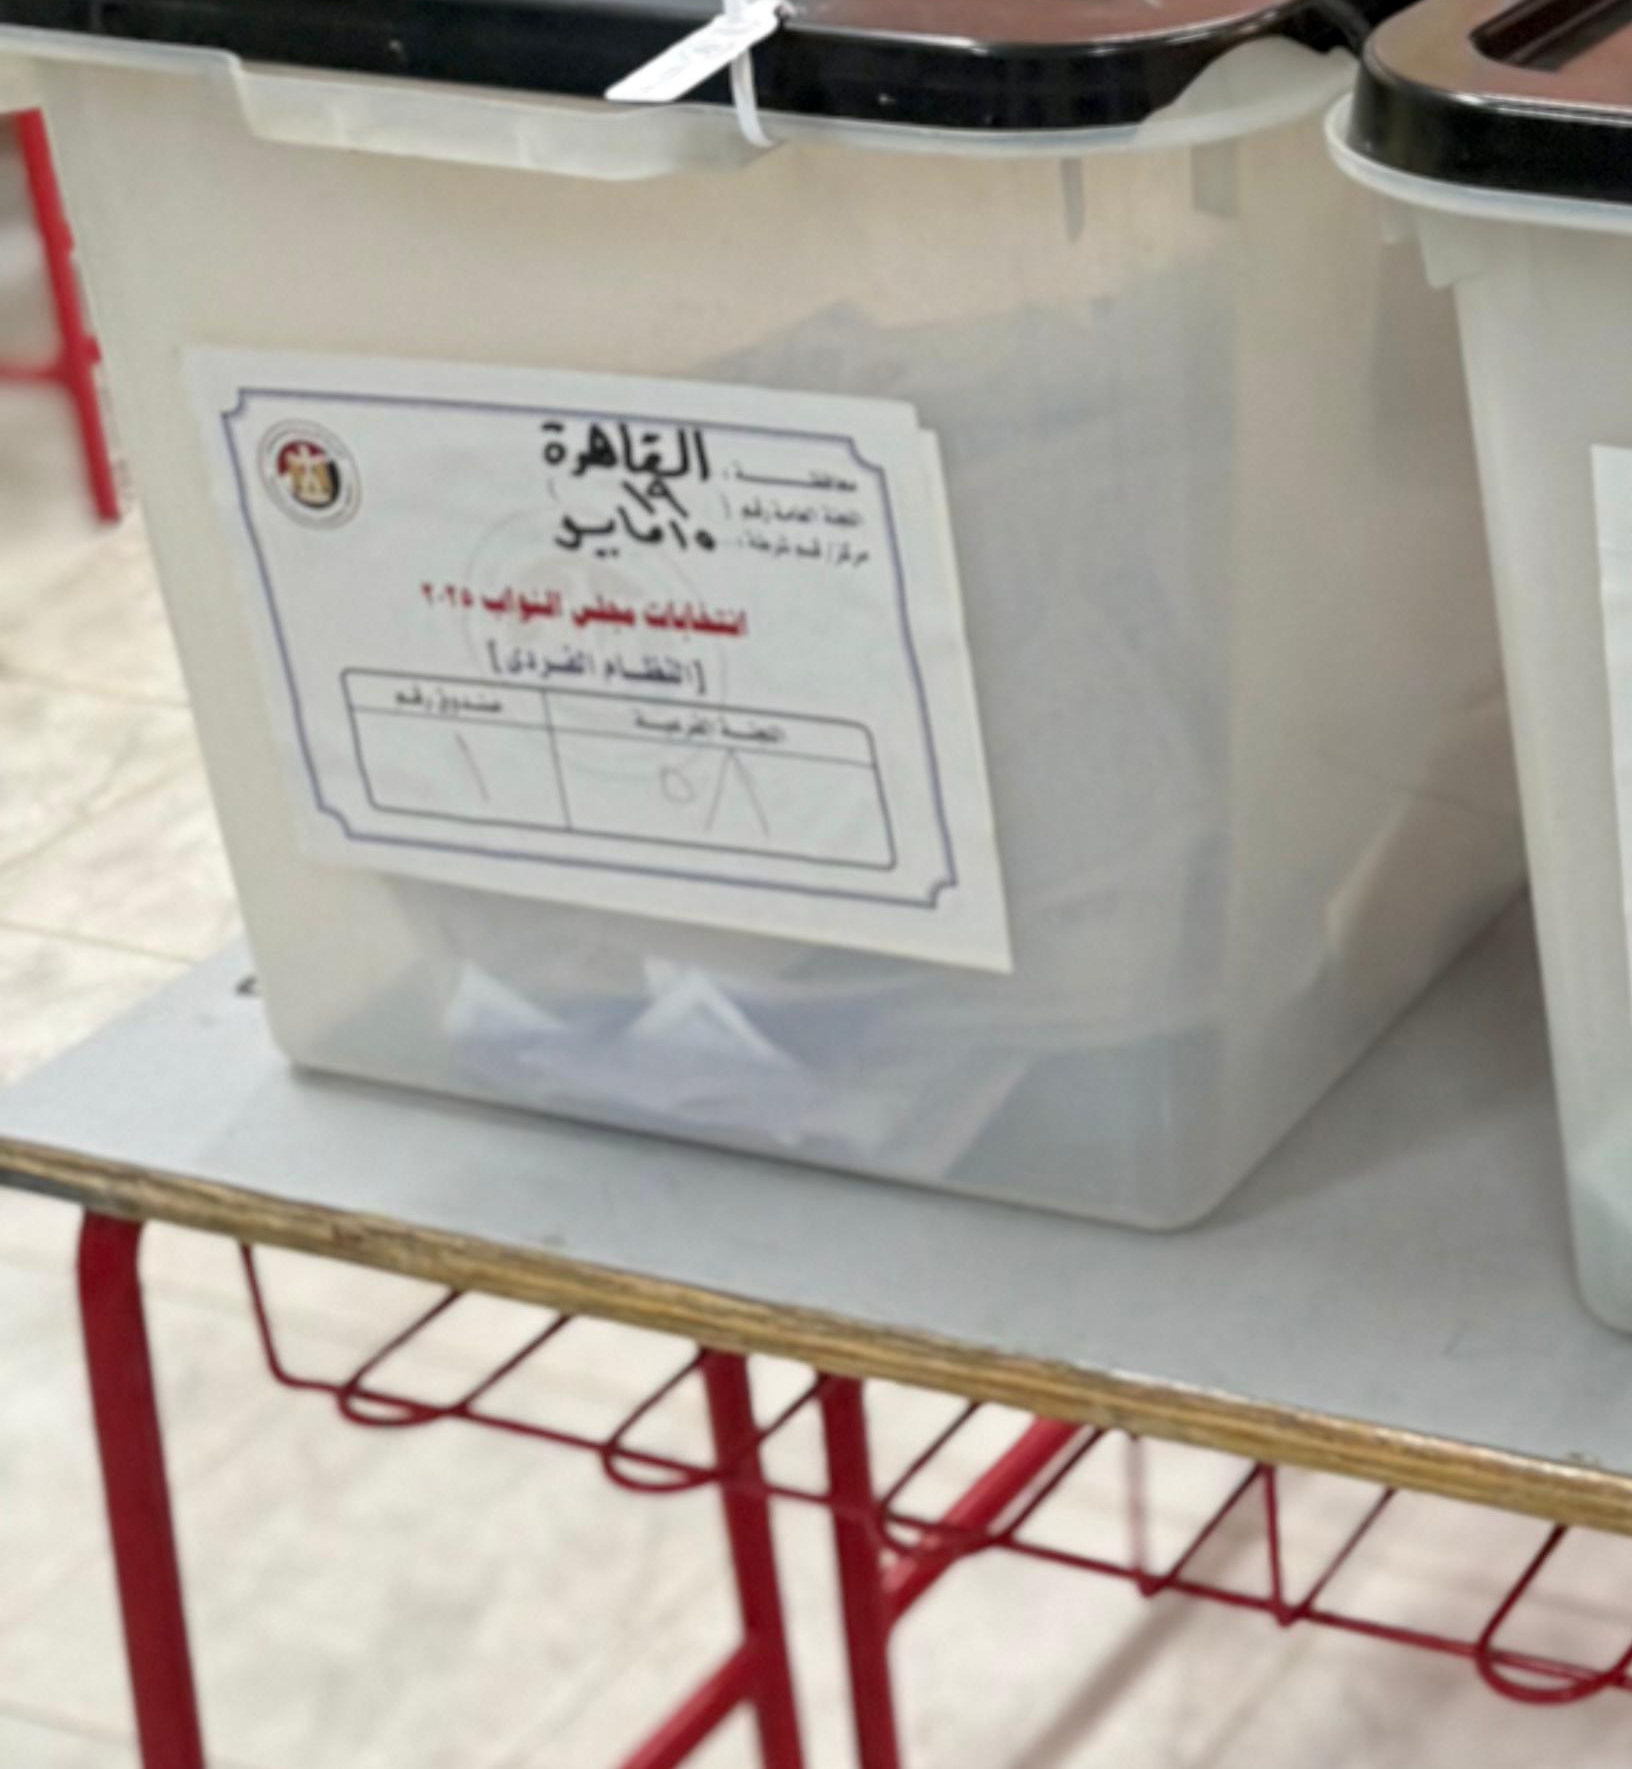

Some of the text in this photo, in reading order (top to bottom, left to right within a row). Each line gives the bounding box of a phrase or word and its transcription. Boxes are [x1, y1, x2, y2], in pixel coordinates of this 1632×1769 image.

[480, 585, 563, 624] النواب
[571, 592, 637, 635] مجلس
[642, 601, 748, 642] انتخابات
